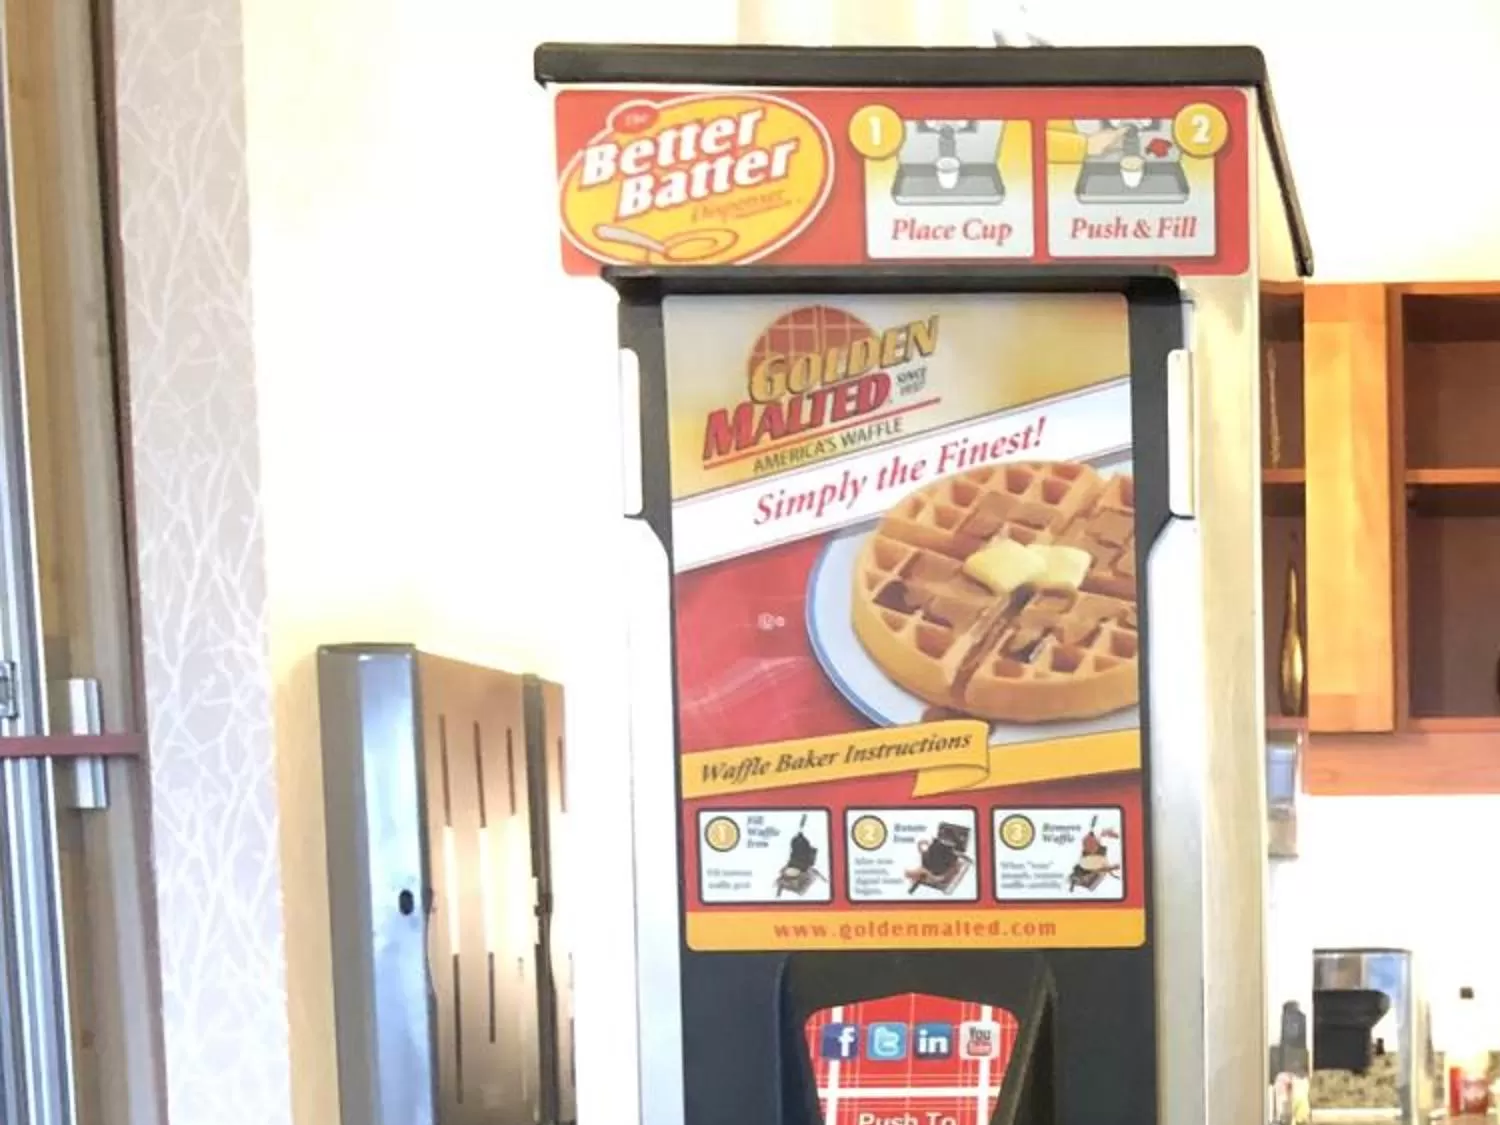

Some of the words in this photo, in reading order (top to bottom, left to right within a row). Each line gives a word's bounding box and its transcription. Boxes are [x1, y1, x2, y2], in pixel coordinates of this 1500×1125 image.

[580, 108, 766, 189] Better
[867, 116, 882, 146] 1
[1190, 115, 1212, 144] 2
[616, 139, 800, 219] Batter
[891, 218, 956, 241] Place
[962, 218, 1013, 246] Cup
[1070, 216, 1129, 240] Push
[1132, 218, 1153, 239] &
[1156, 215, 1198, 239] Fill
[749, 313, 941, 405] GOLDEN
[702, 371, 891, 461] MALTED
[753, 436, 838, 473] AMERICA'S
[841, 416, 905, 450] WAFFLE
[753, 470, 869, 525] Simply
[875, 456, 927, 491] the
[935, 415, 1047, 475] Finest!
[700, 755, 772, 785] Waffle
[775, 749, 840, 774] Baker
[843, 731, 973, 765] Instructions
[773, 919, 1058, 941] www.goldenmalted.com
[917, 1028, 949, 1054] in
